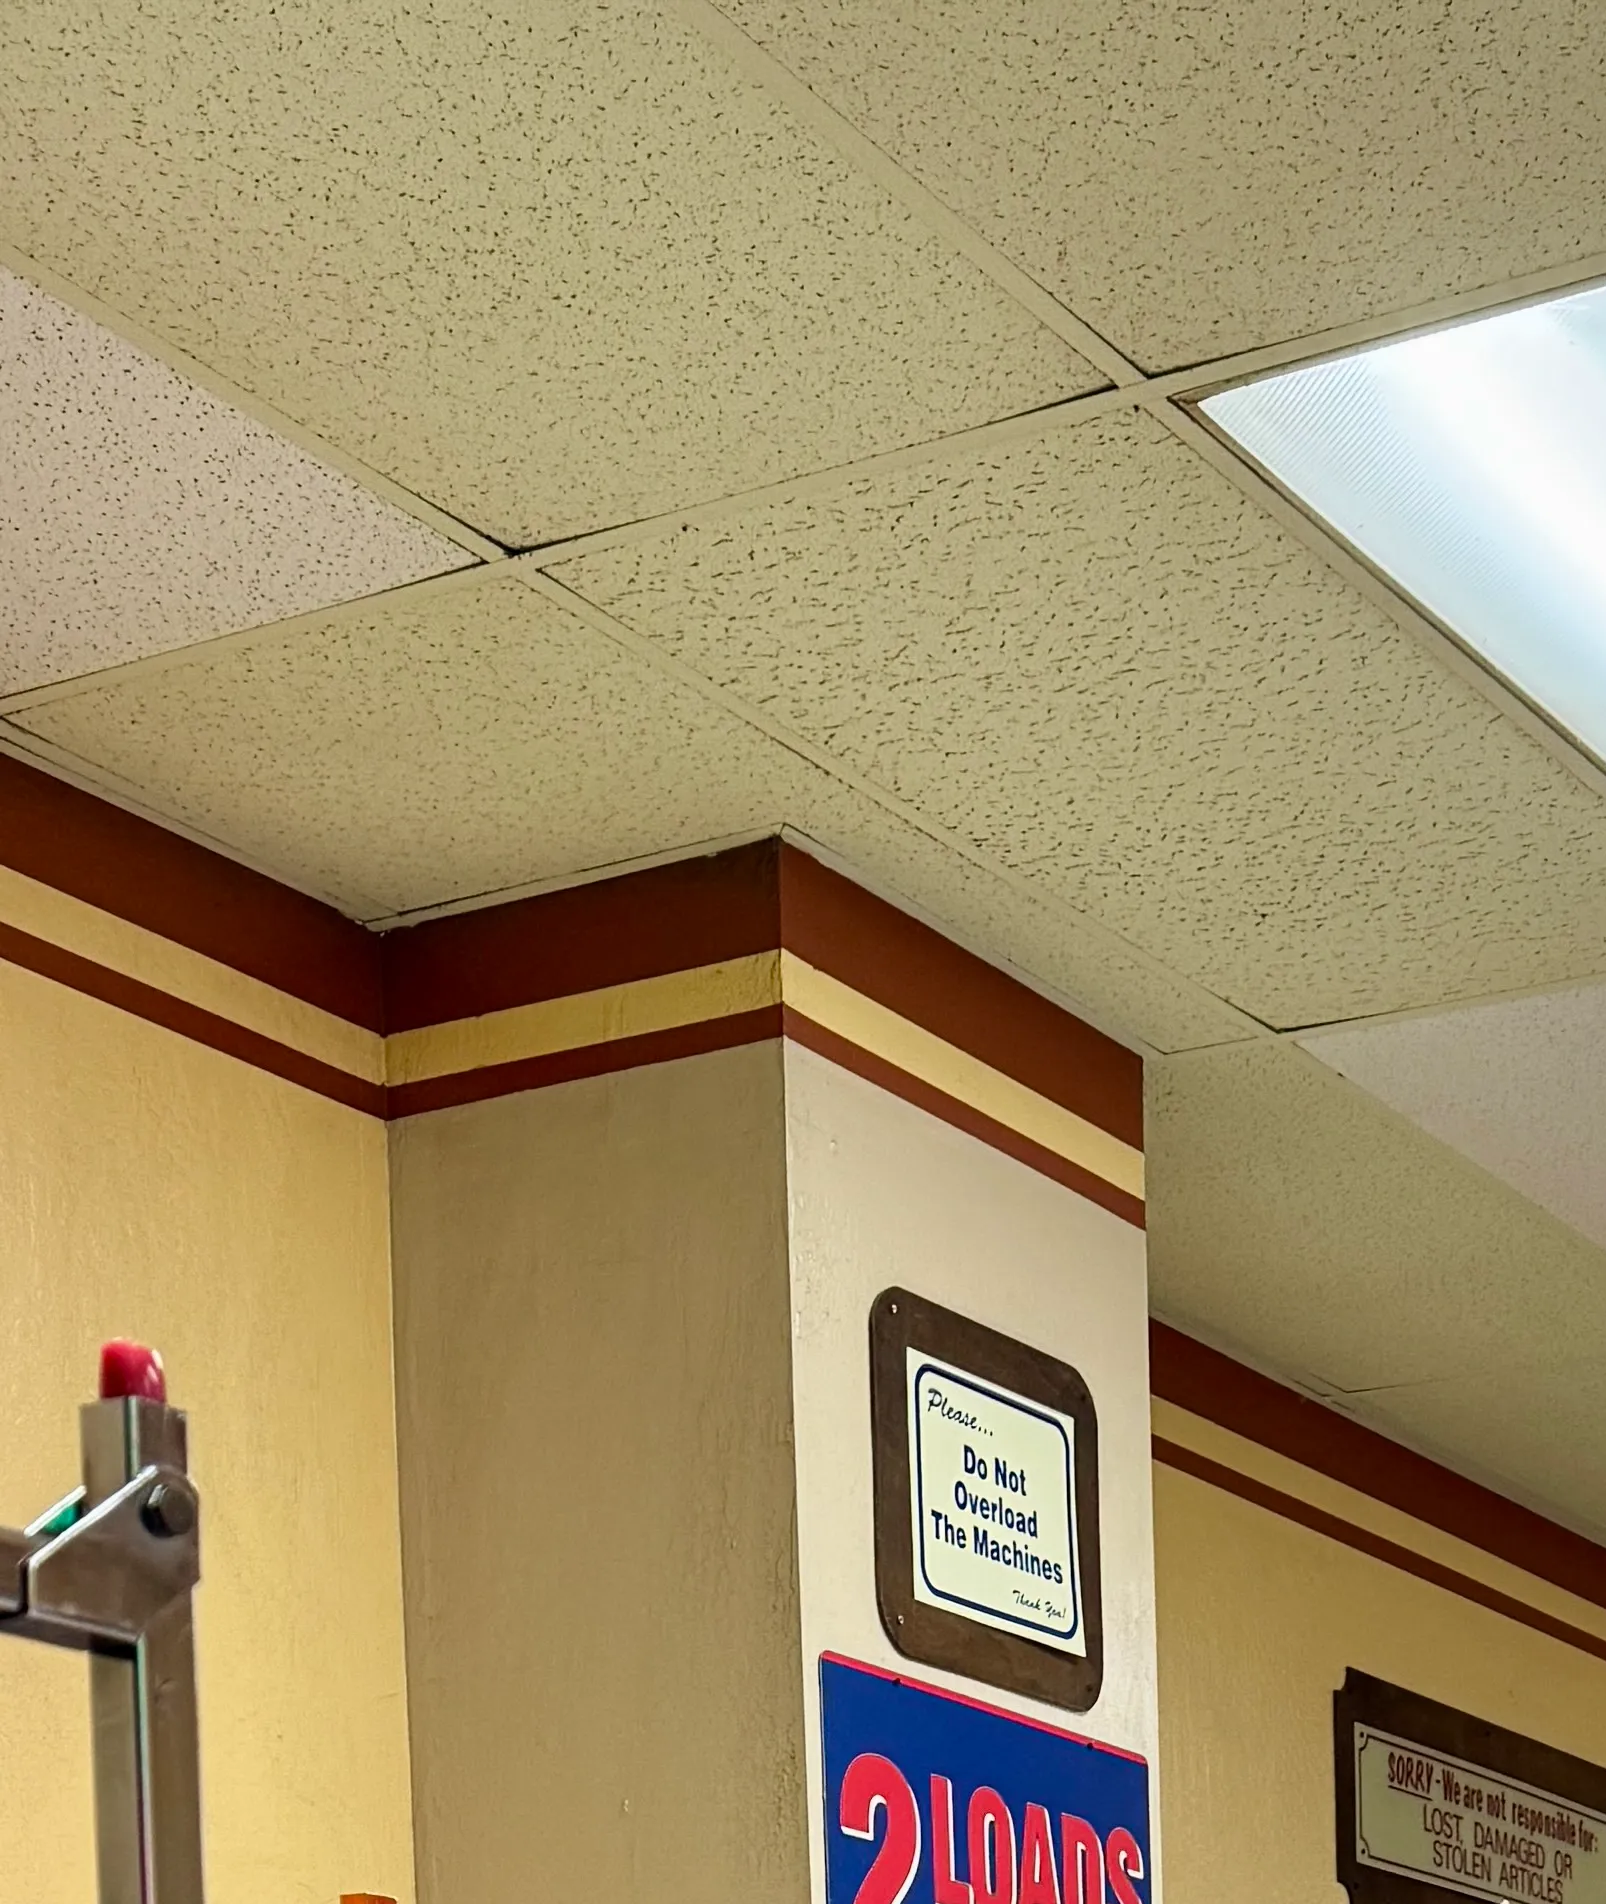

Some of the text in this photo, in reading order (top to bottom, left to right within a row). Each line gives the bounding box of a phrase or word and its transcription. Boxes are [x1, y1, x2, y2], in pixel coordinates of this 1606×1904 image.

[928, 1388, 993, 1436] Please...
[964, 1444, 1026, 1496] Do Not
[954, 1481, 1037, 1538] Overload
[931, 1509, 1063, 1584] The Machines
[1012, 1590, 1040, 1611] Thank
[1388, 1752, 1434, 1796] SORRY
[1464, 1785, 1482, 1812] are
[1487, 1792, 1506, 1821] not
[1512, 1803, 1576, 1846] responsible
[1424, 1804, 1572, 1879] LOST, DAMAGED OR
[1433, 1840, 1563, 1904] STOLEN ARTICLES
